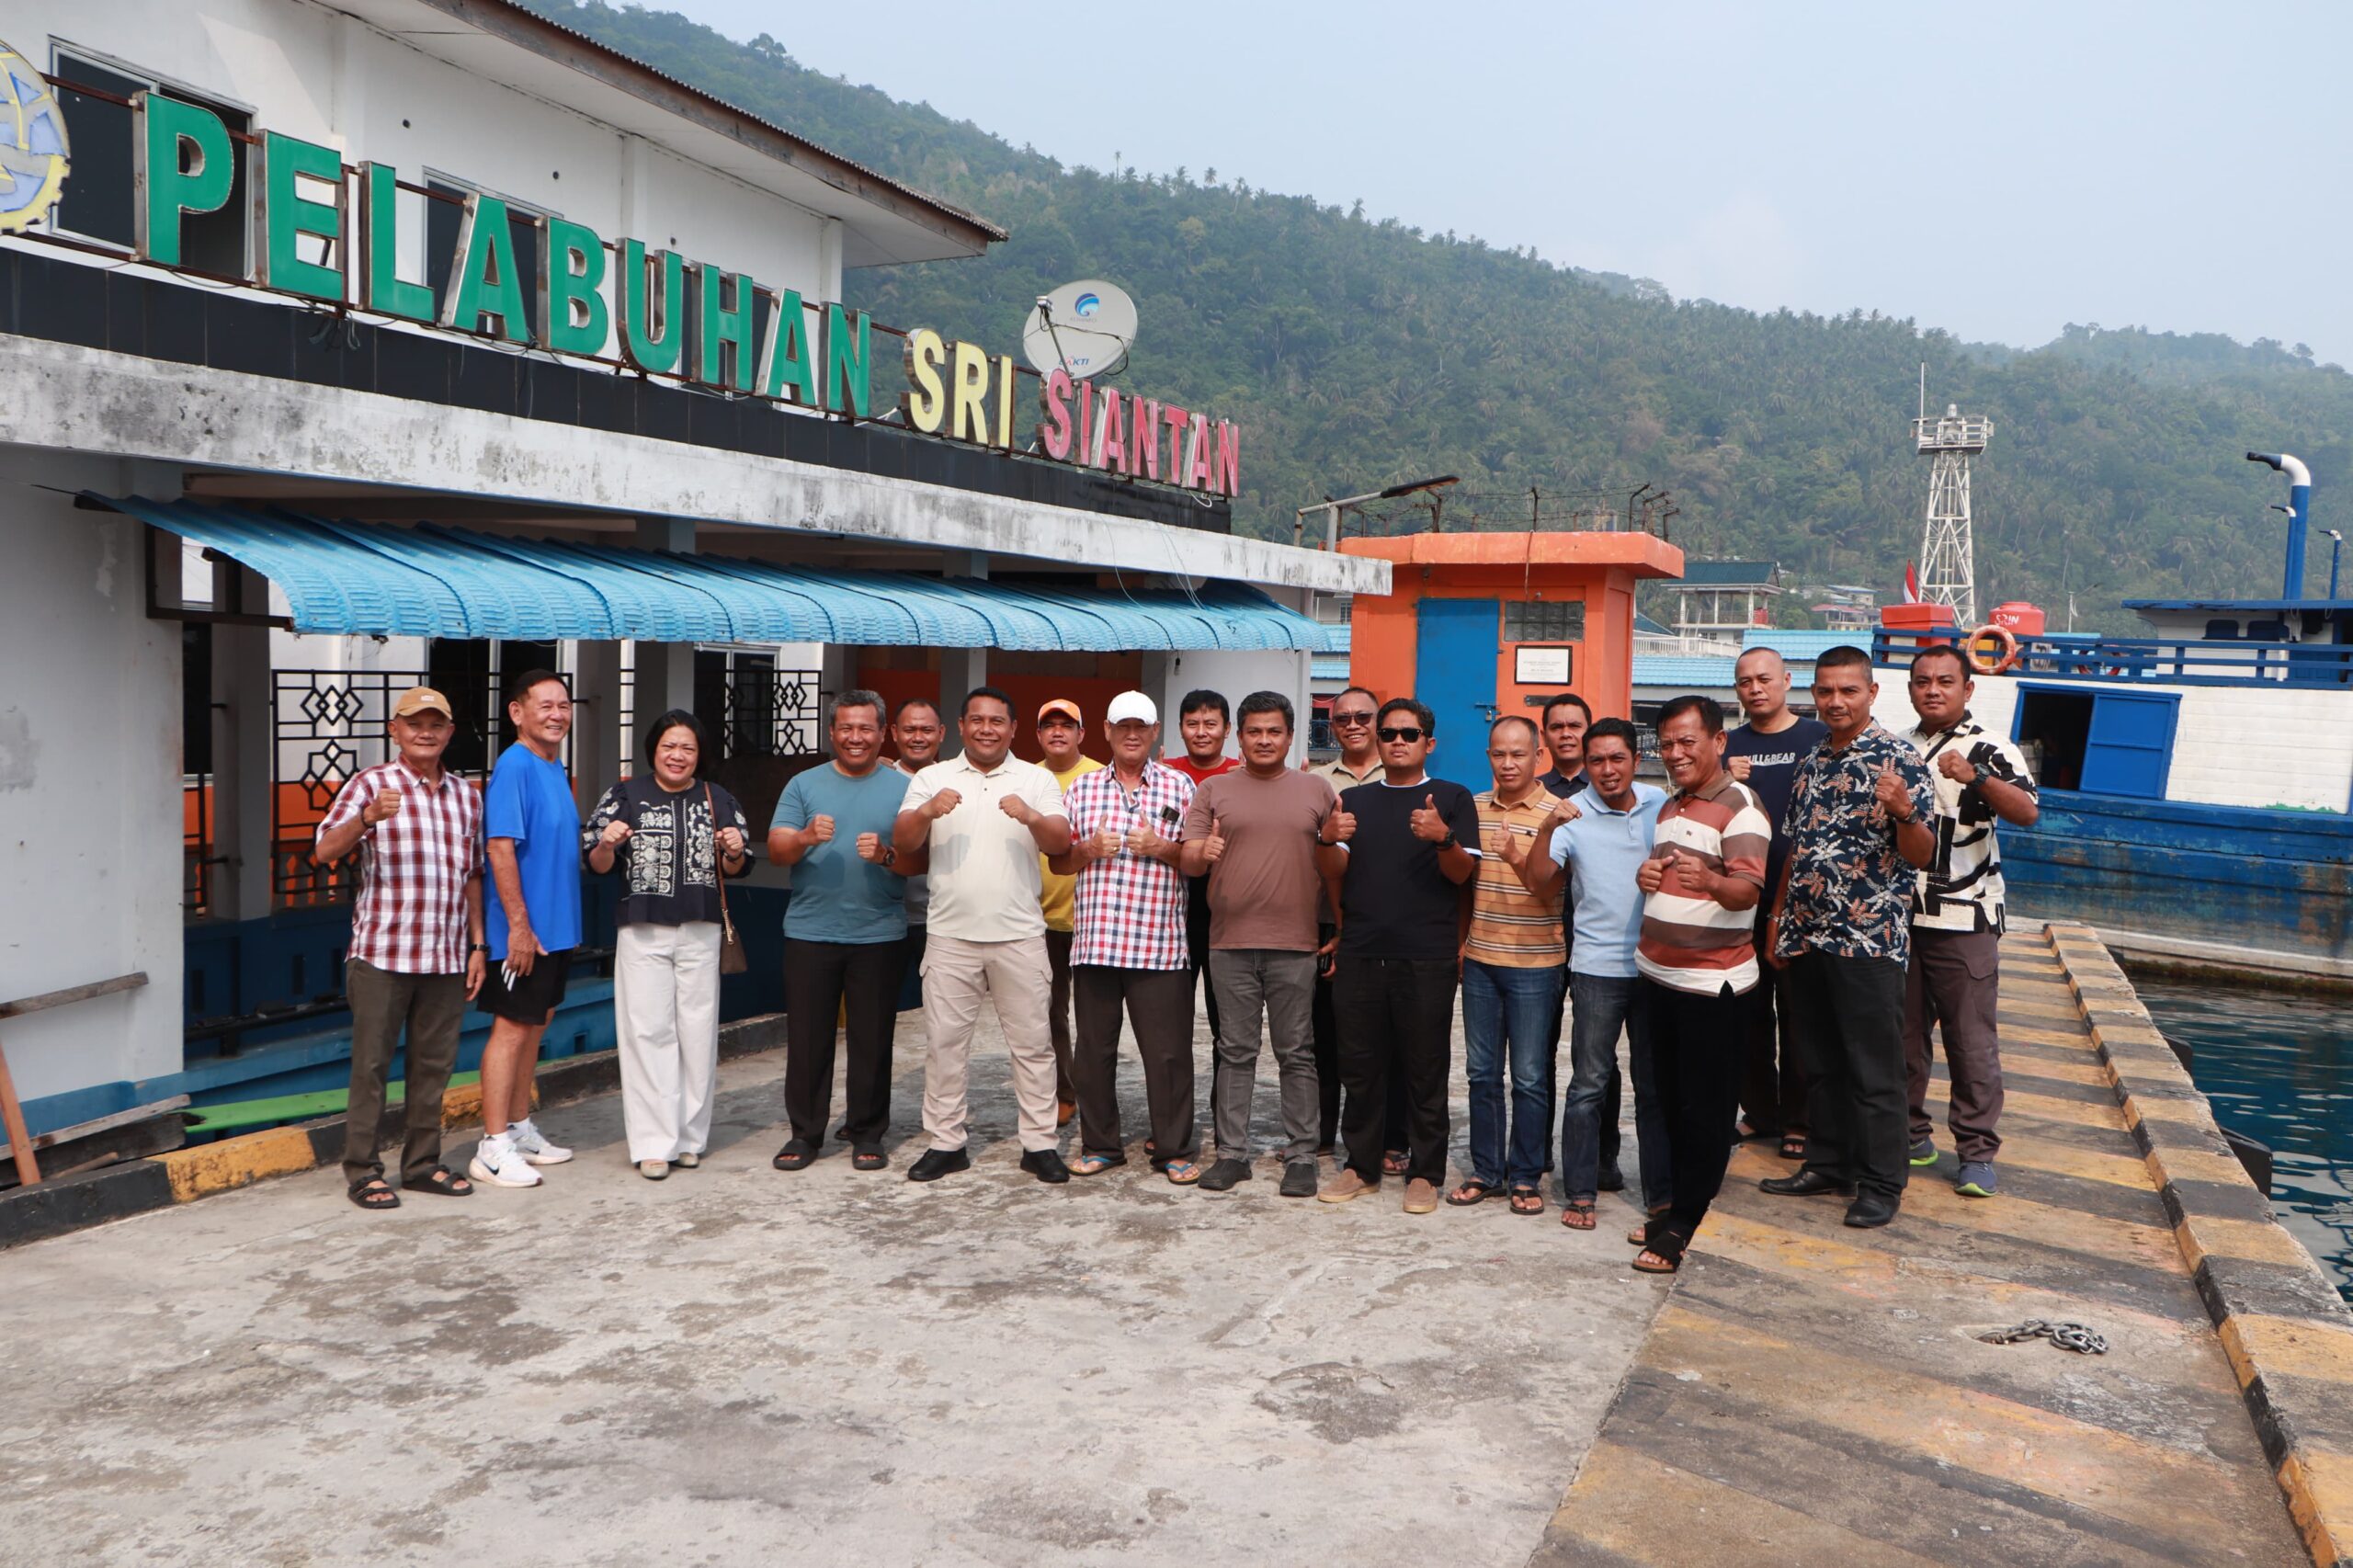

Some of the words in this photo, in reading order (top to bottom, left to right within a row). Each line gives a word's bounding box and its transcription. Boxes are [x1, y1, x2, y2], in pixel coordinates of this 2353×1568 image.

[133, 90, 870, 418] PELABUHAN
[902, 327, 1012, 449] SRI
[1038, 368, 1239, 497] SIANTAN
